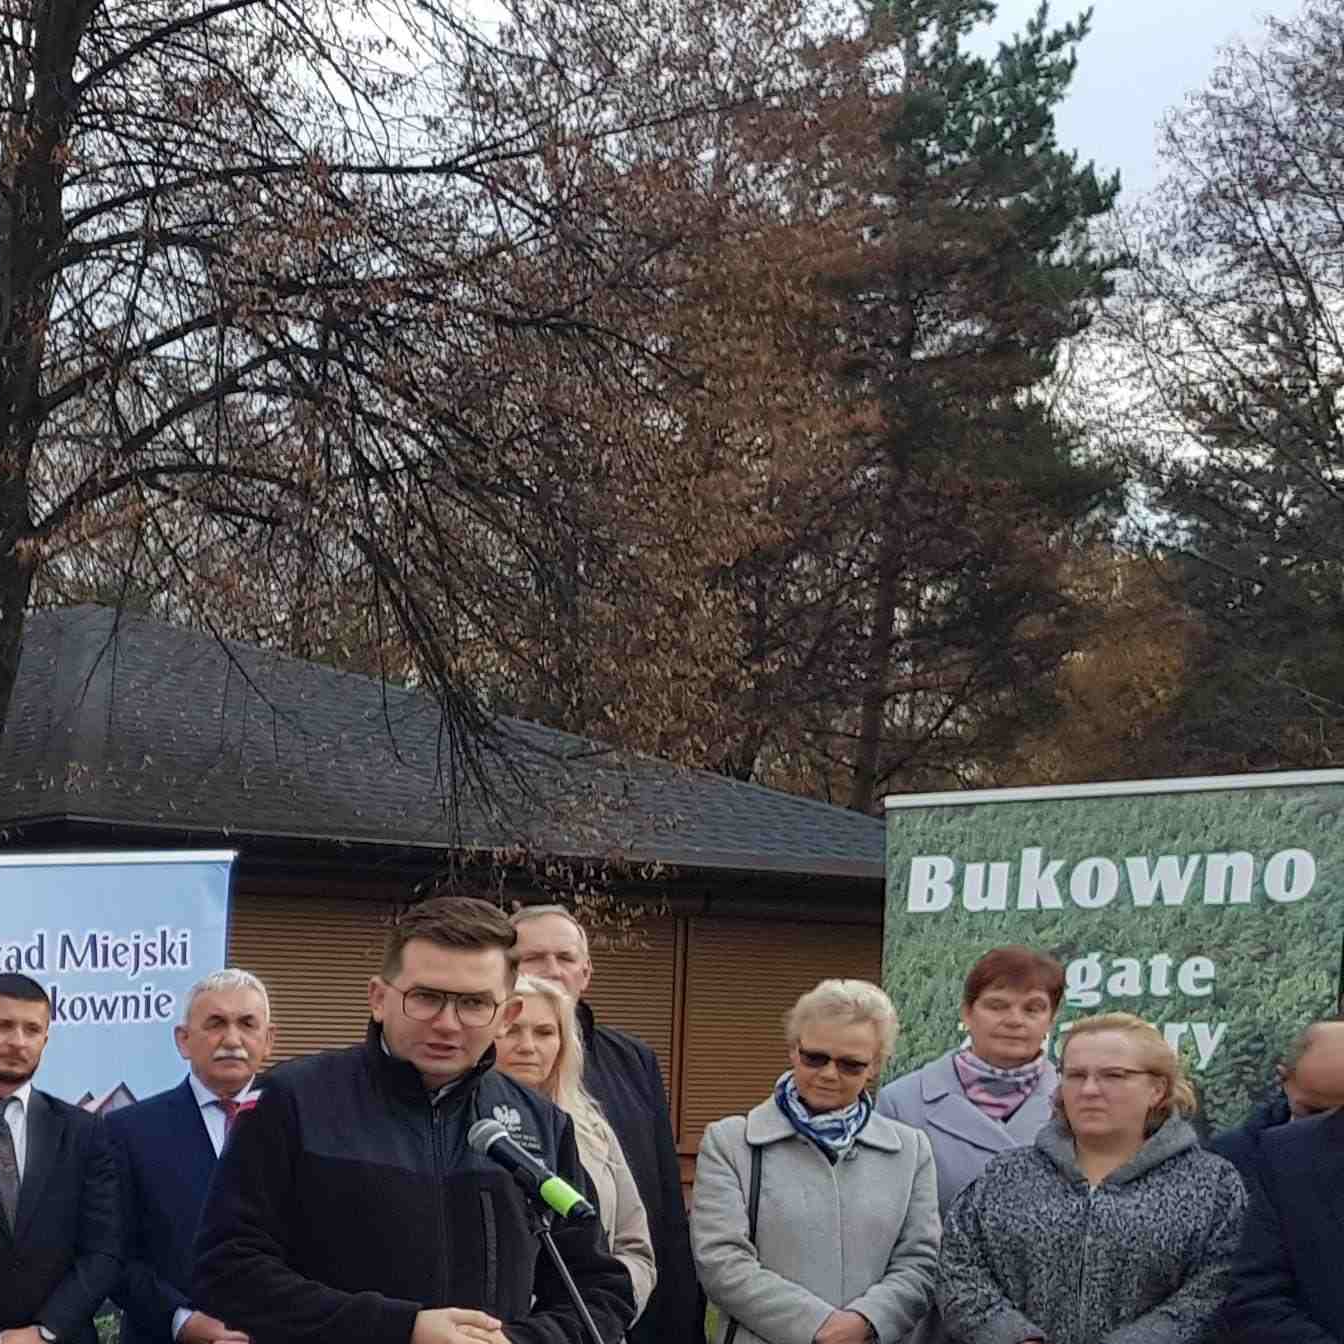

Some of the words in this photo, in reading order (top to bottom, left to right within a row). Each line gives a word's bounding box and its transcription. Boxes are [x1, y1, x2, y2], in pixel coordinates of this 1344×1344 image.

[907, 847, 1317, 913] Bukowno
[60, 929, 189, 976] Miejski
[49, 986, 172, 1022] kownie
[1064, 950, 1216, 1008] gate
